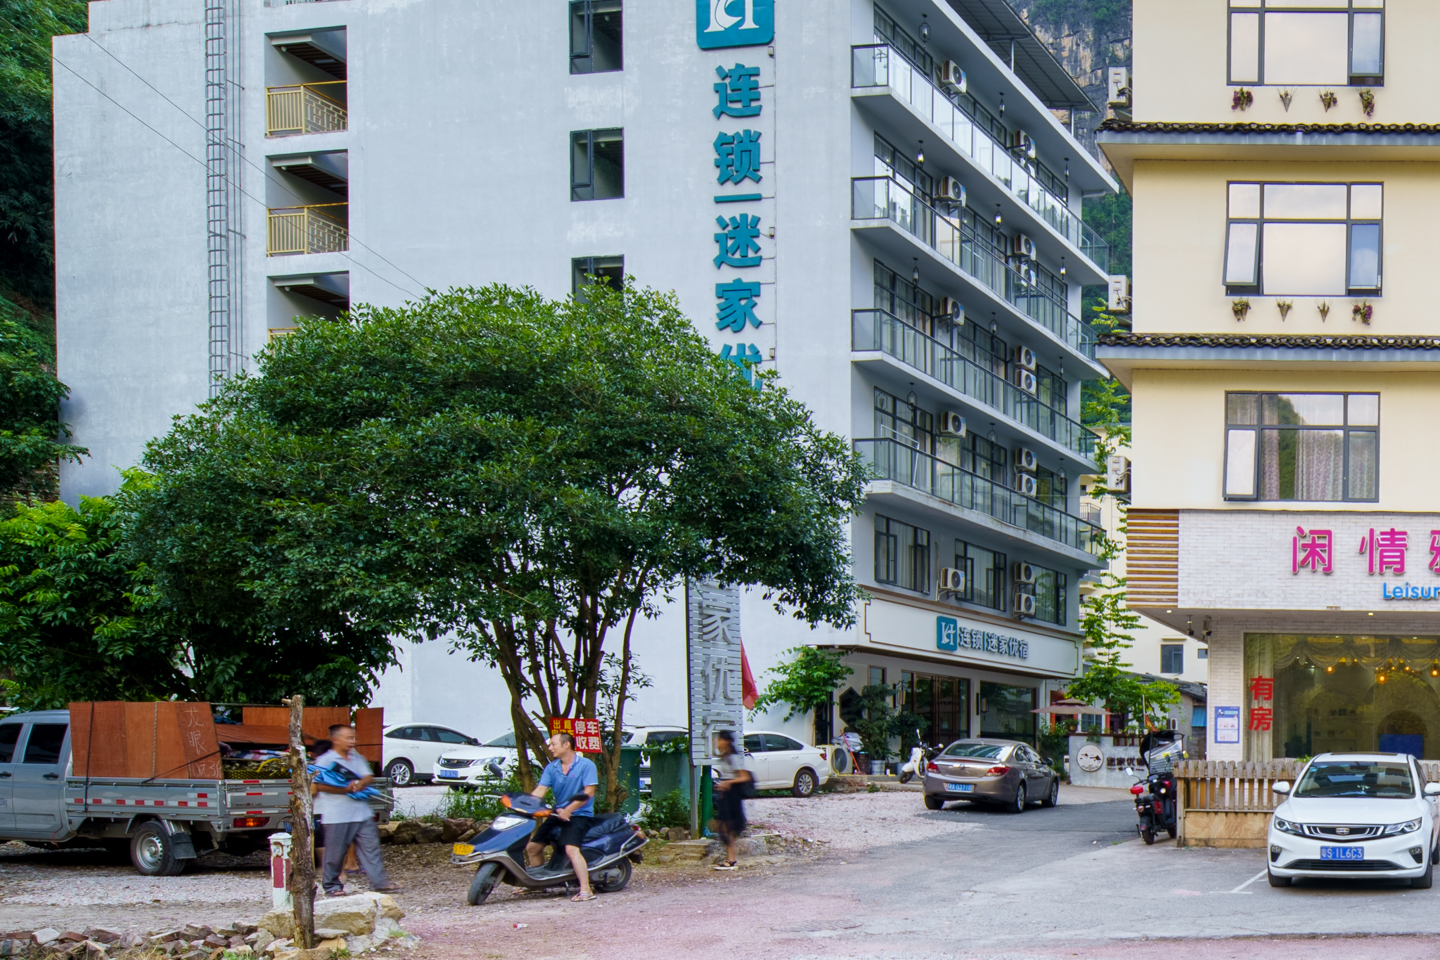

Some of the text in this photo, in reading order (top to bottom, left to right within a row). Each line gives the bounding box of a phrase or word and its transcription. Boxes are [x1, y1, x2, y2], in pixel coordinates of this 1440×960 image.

[1248, 675, 1276, 732] 有房
[575, 720, 598, 735] 停车
[576, 735, 600, 750] 收费
